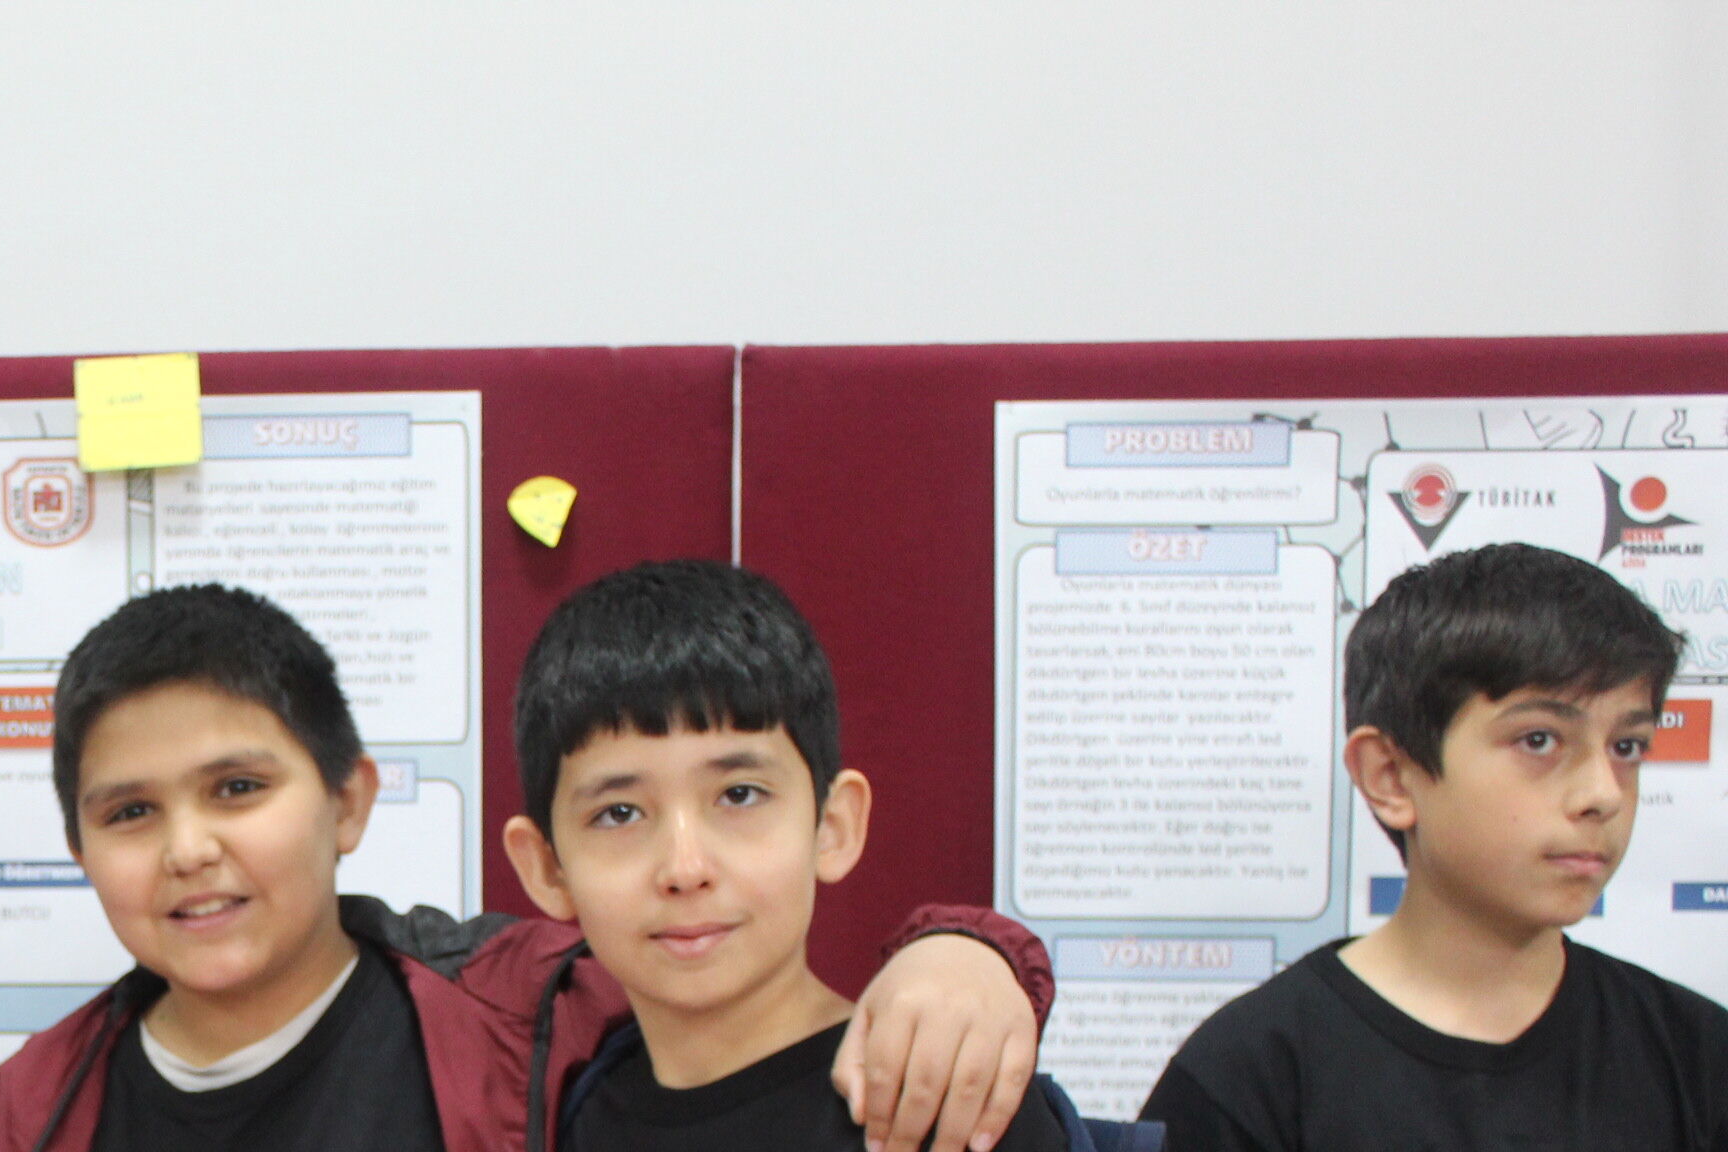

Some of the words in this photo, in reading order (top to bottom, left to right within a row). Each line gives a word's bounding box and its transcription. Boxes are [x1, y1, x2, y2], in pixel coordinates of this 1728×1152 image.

[252, 419, 360, 451] SONUÇ
[1104, 427, 1256, 453] PROBLEM
[1478, 486, 1557, 507] TÜBİTAK
[1128, 530, 1208, 562] ÖZET
[1100, 936, 1234, 970] YÖNTEM
